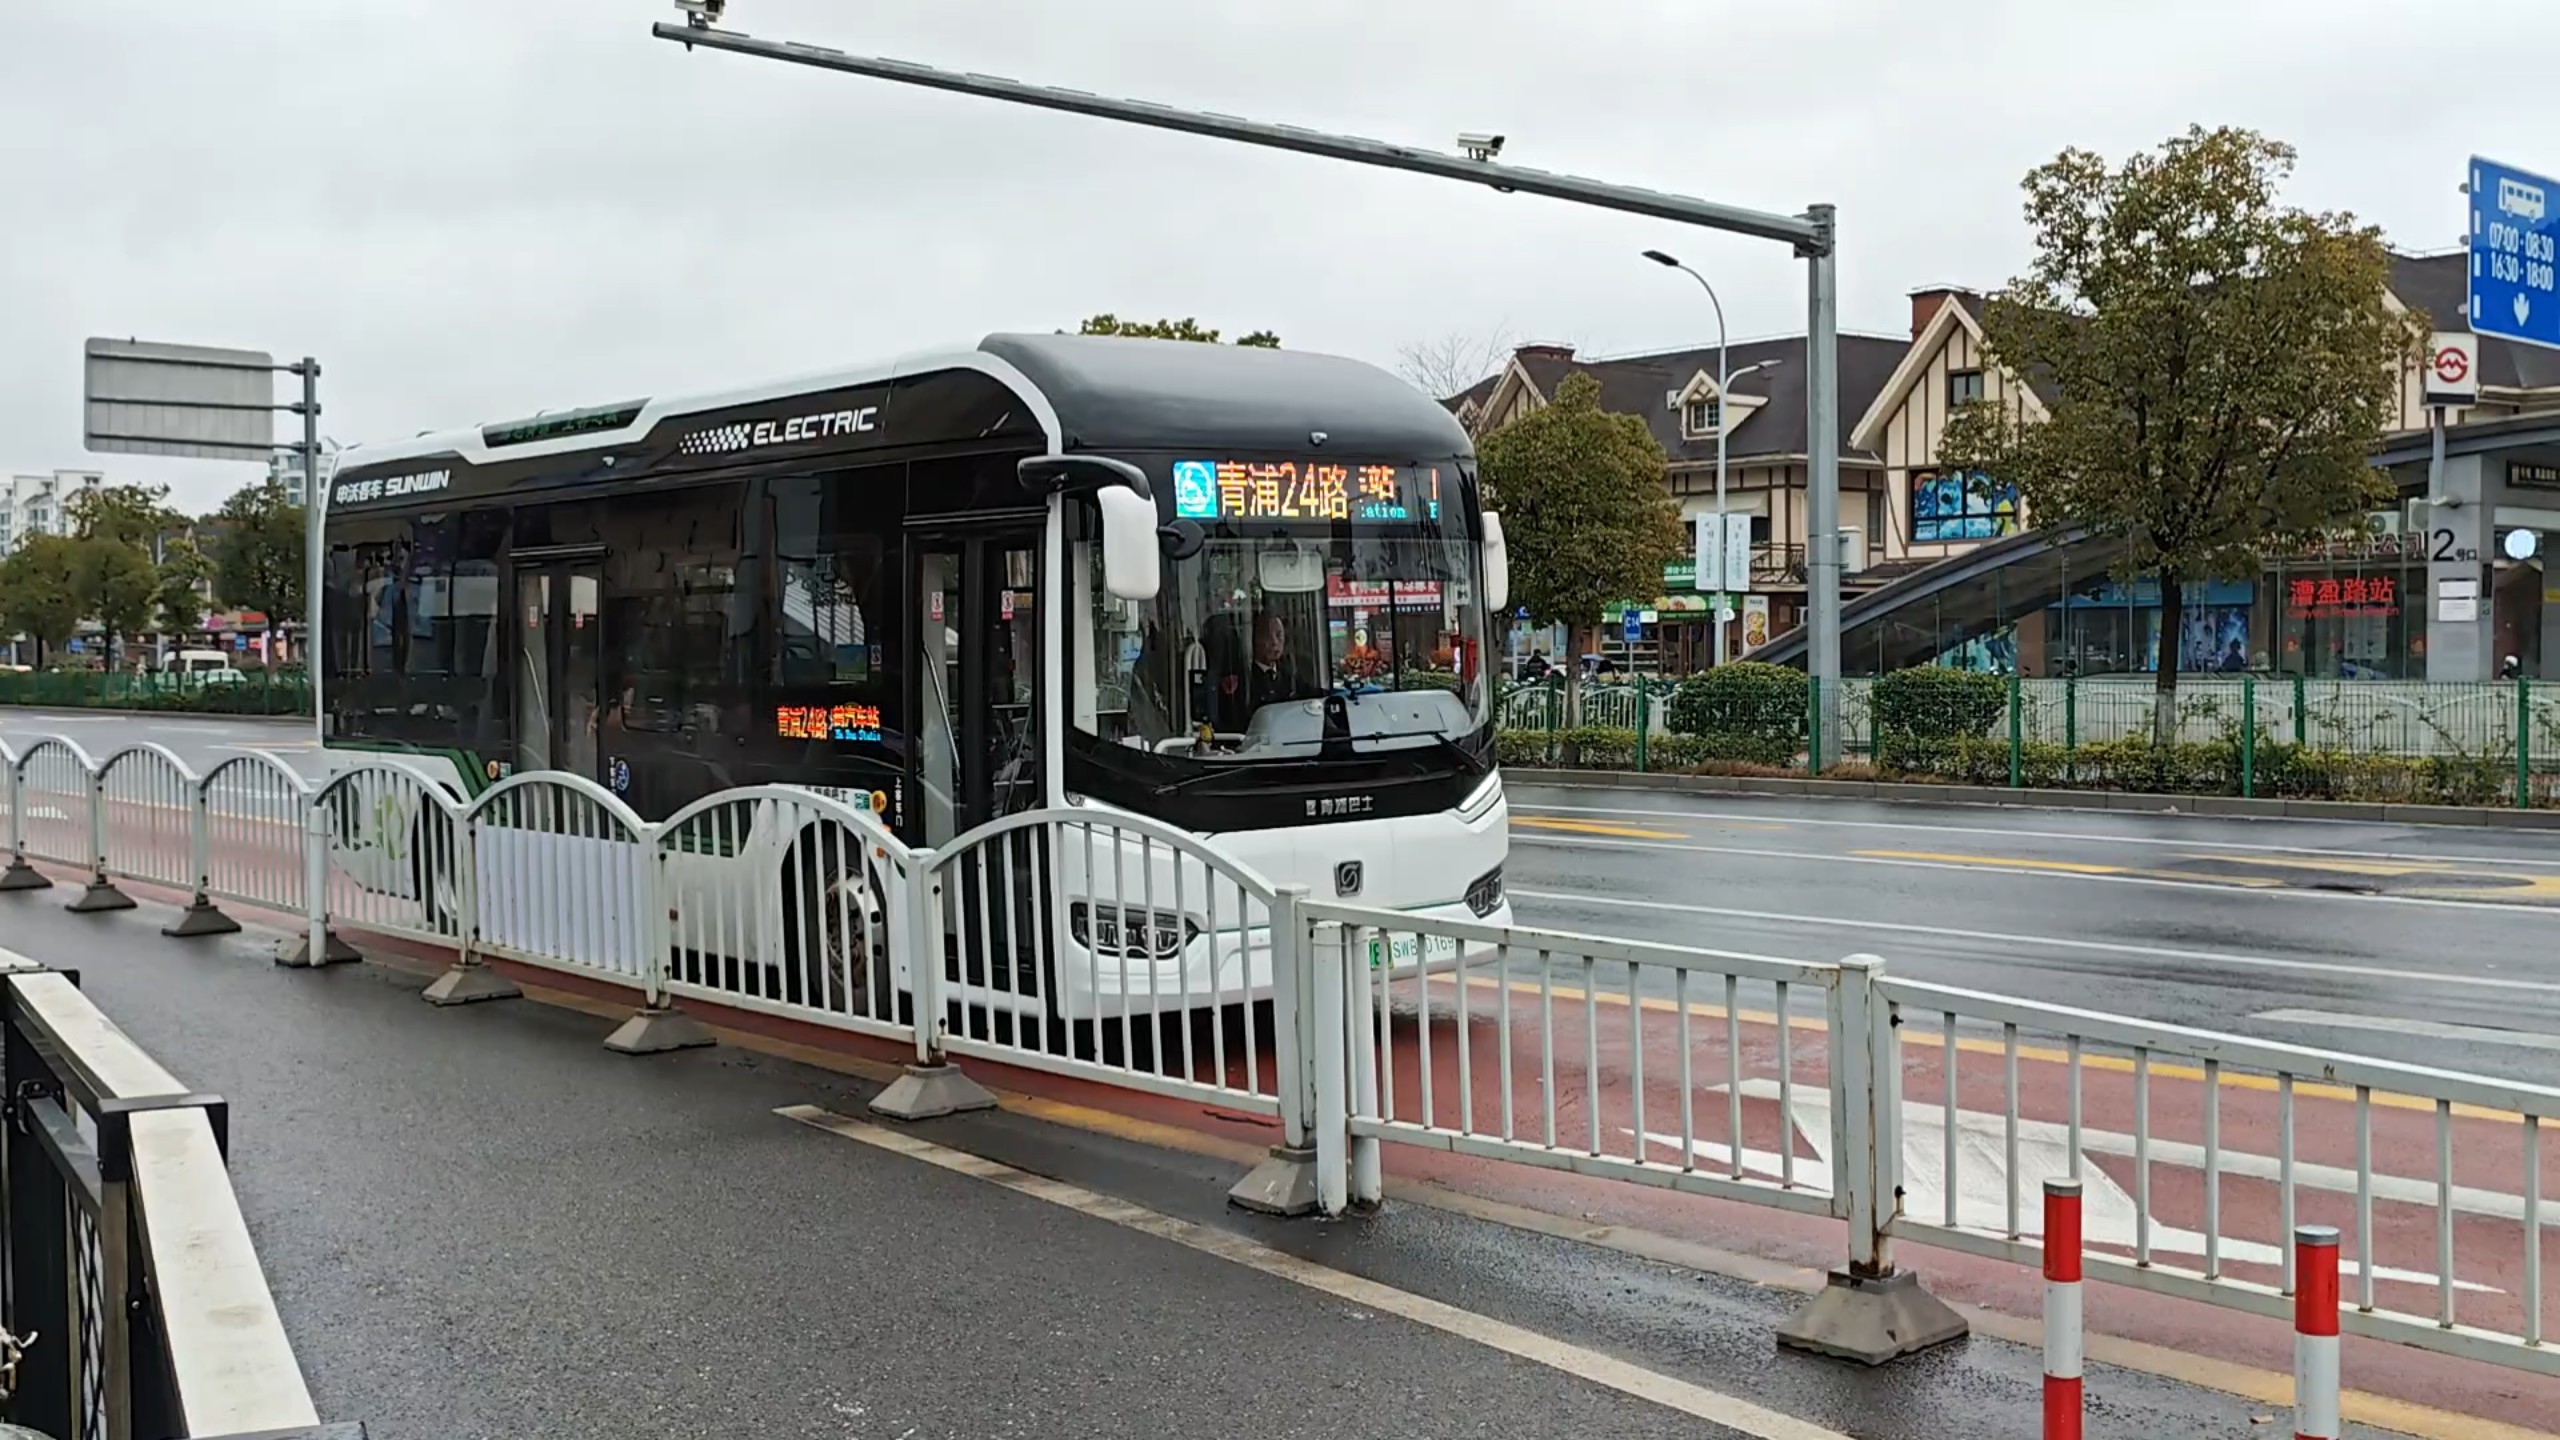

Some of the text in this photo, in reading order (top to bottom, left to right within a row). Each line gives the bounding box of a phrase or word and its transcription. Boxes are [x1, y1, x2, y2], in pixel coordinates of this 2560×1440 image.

[753, 407, 877, 445] ELECTRIC
[336, 469, 450, 504] 申沃客车 SUNWIN
[1216, 460, 1348, 520] 青浦24路
